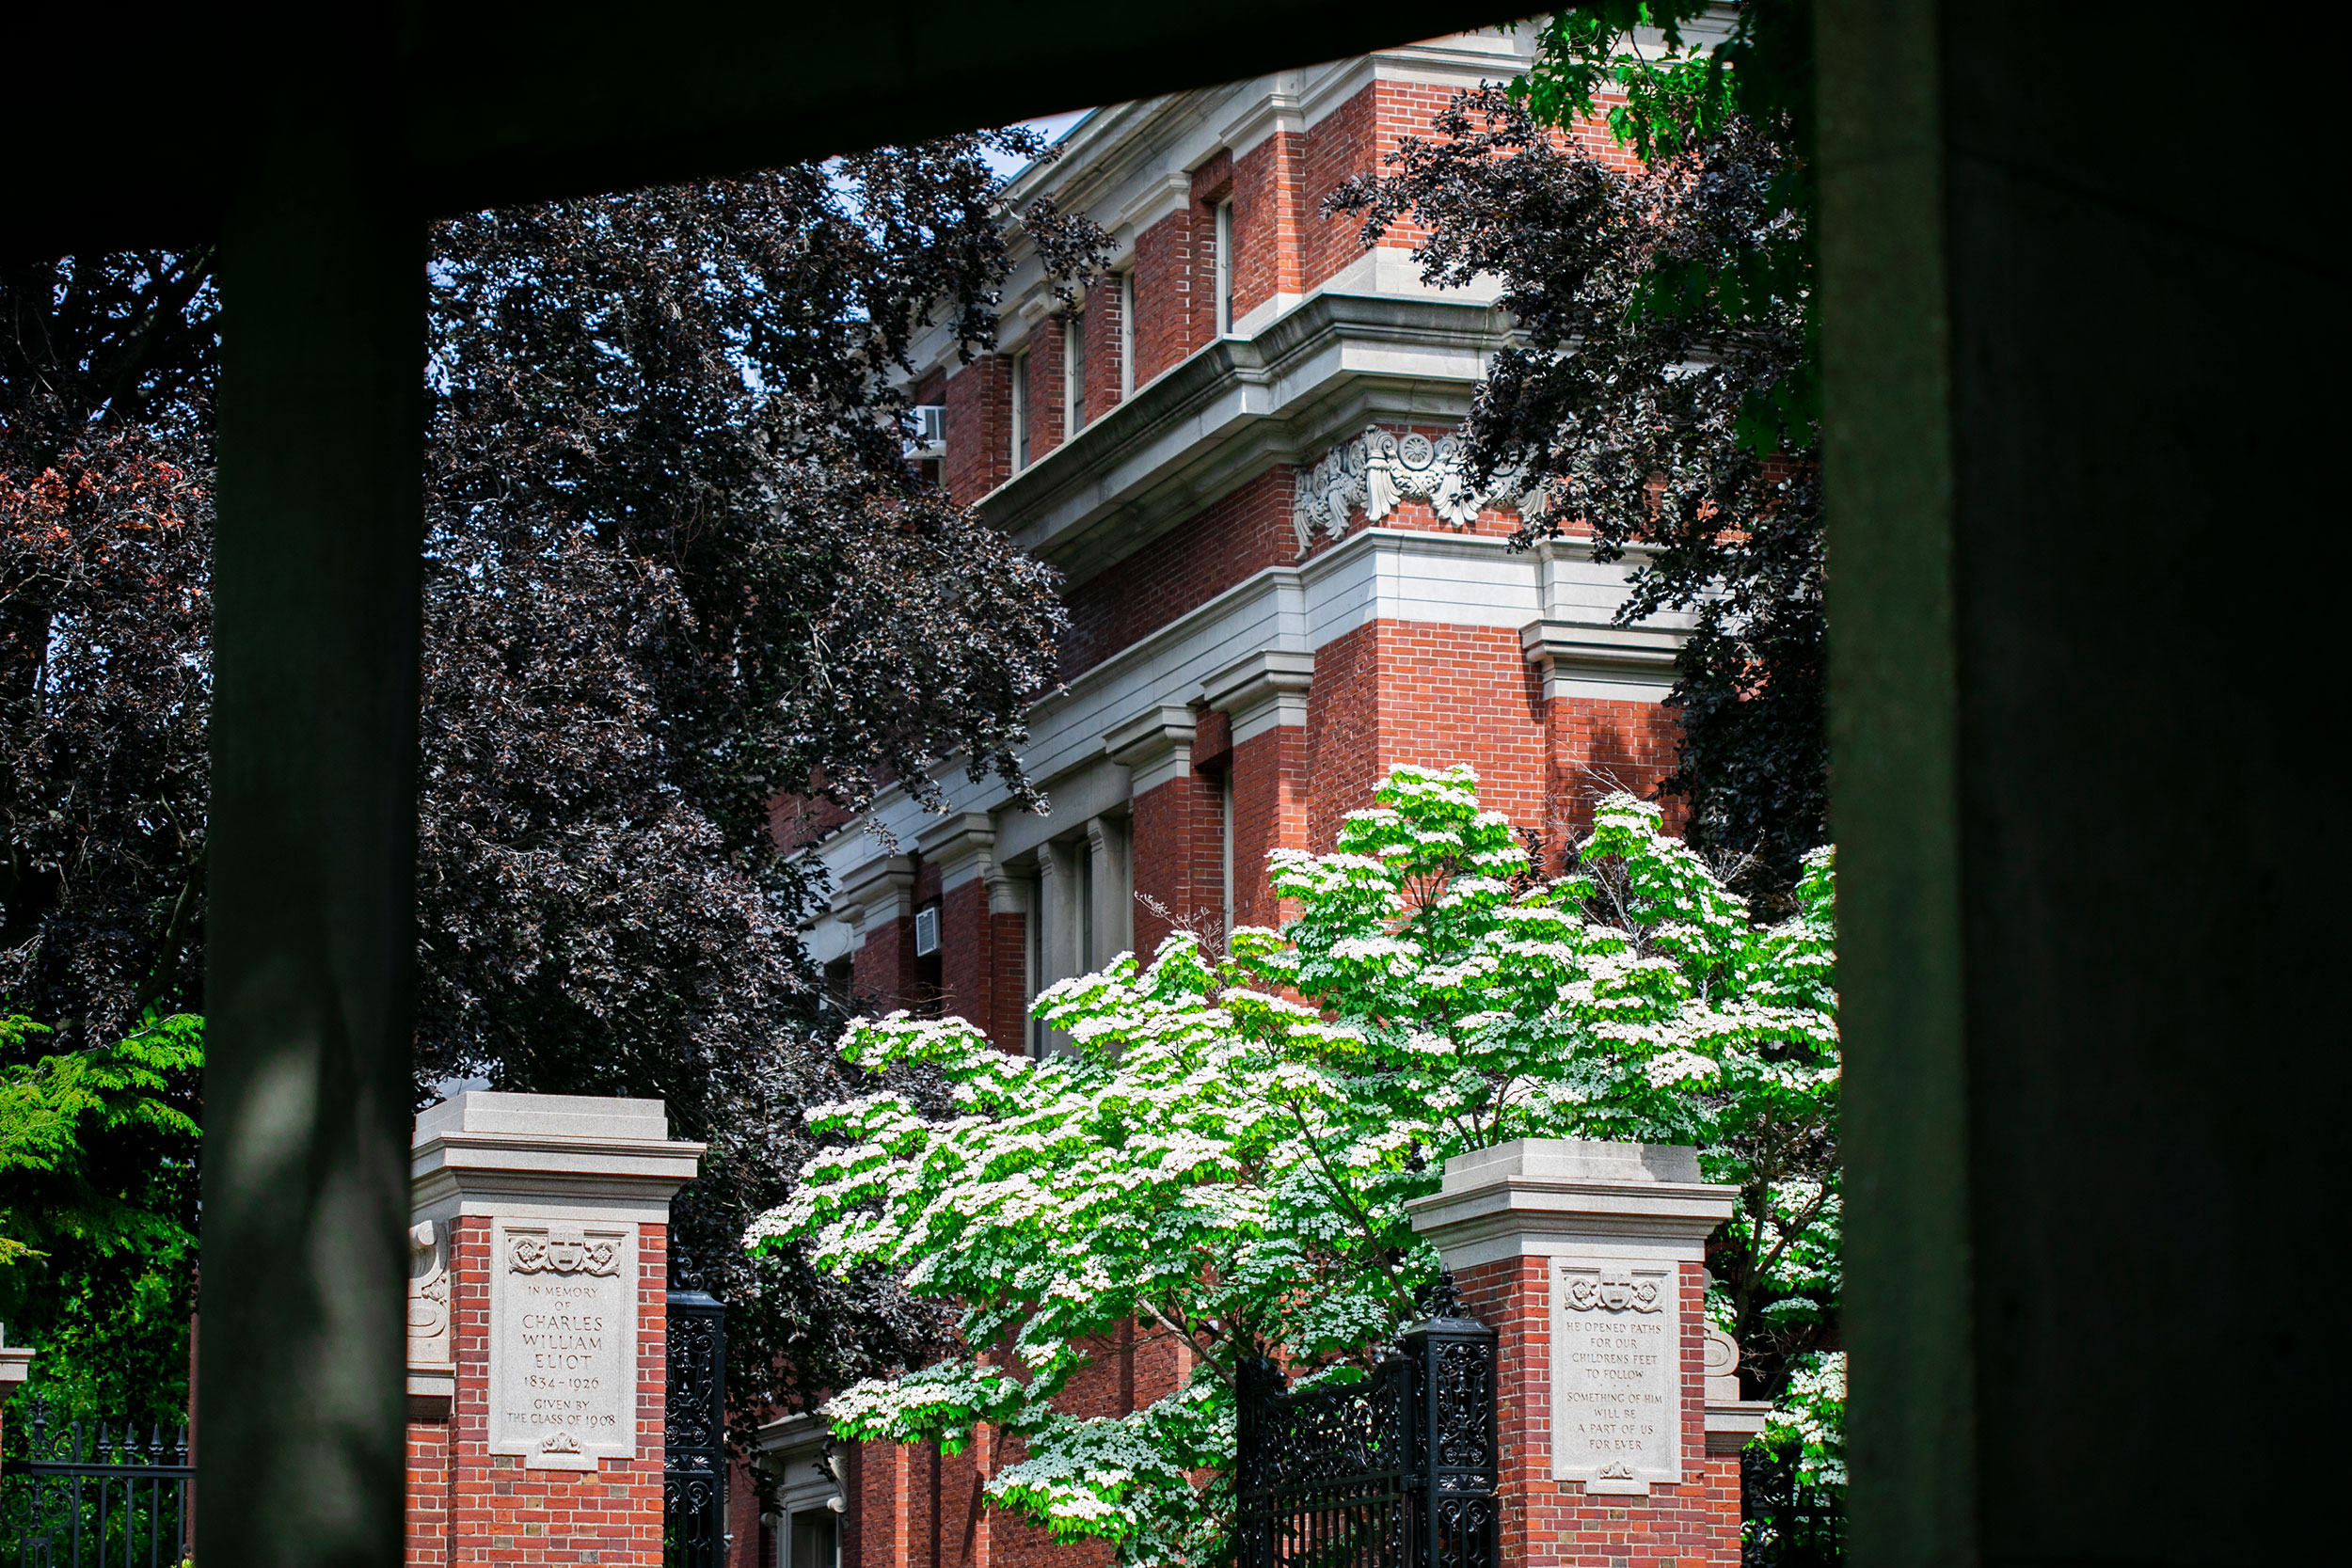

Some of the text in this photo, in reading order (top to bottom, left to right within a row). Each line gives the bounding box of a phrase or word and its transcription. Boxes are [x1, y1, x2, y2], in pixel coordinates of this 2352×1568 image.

[528, 1286, 598, 1297] IN MEMORY
[555, 1301, 571, 1311] OF
[522, 1315, 603, 1331] CHARLES
[1567, 1322, 1661, 1334] HE OPENED PATHS
[523, 1335, 602, 1350] WILLIAM
[1591, 1338, 1637, 1349] FOR OUR
[536, 1354, 592, 1369] ELIOT
[1572, 1353, 1657, 1365] CHILDRENS FEET
[1586, 1369, 1644, 1379] TO FOLLOW
[1567, 1392, 1662, 1404] SOMETHING OF HIM
[534, 1399, 590, 1410] GIVEN BY
[1594, 1408, 1636, 1418] WILL BE
[507, 1413, 616, 1428] THE CLASS OF 1908
[1578, 1424, 1653, 1435] A PART OF US
[1589, 1439, 1643, 1450] FOR EVER
